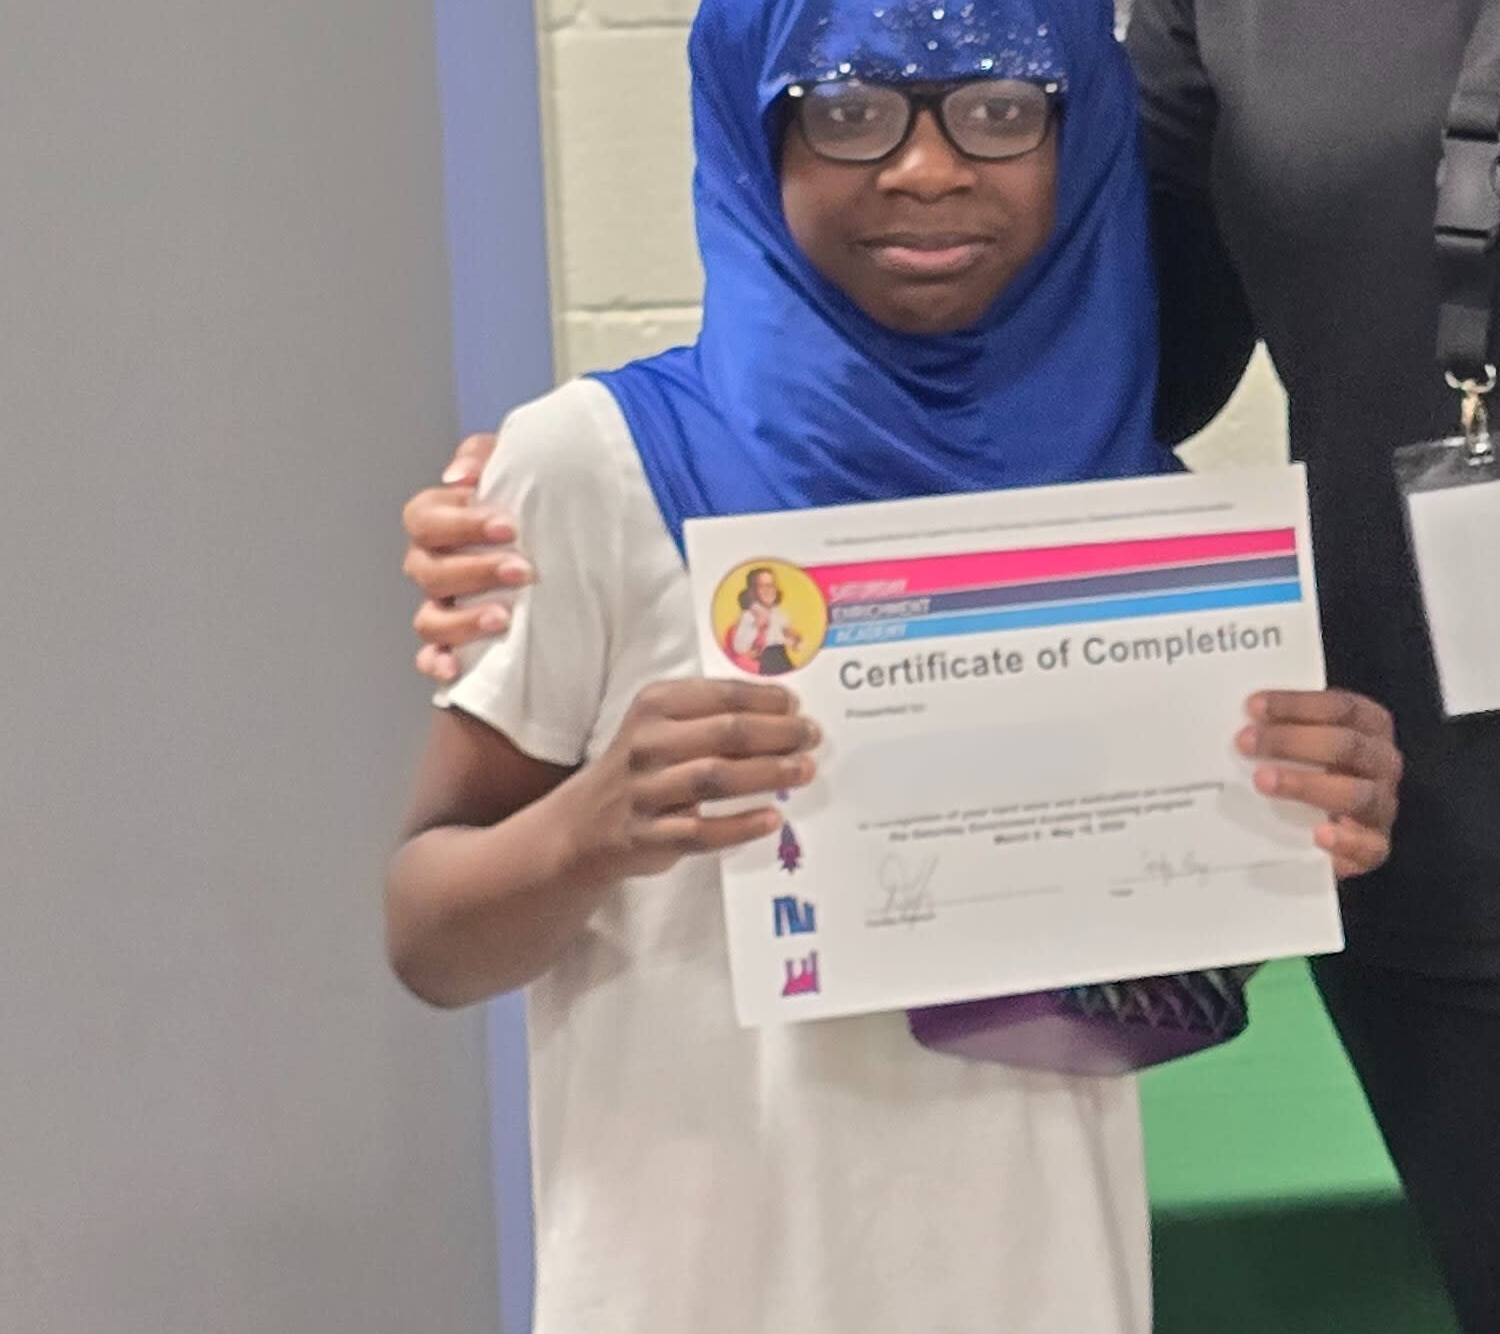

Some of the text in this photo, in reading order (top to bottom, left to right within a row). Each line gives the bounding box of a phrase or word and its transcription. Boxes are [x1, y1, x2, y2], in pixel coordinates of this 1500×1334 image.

[838, 624, 1282, 691] Certificate of Completion
